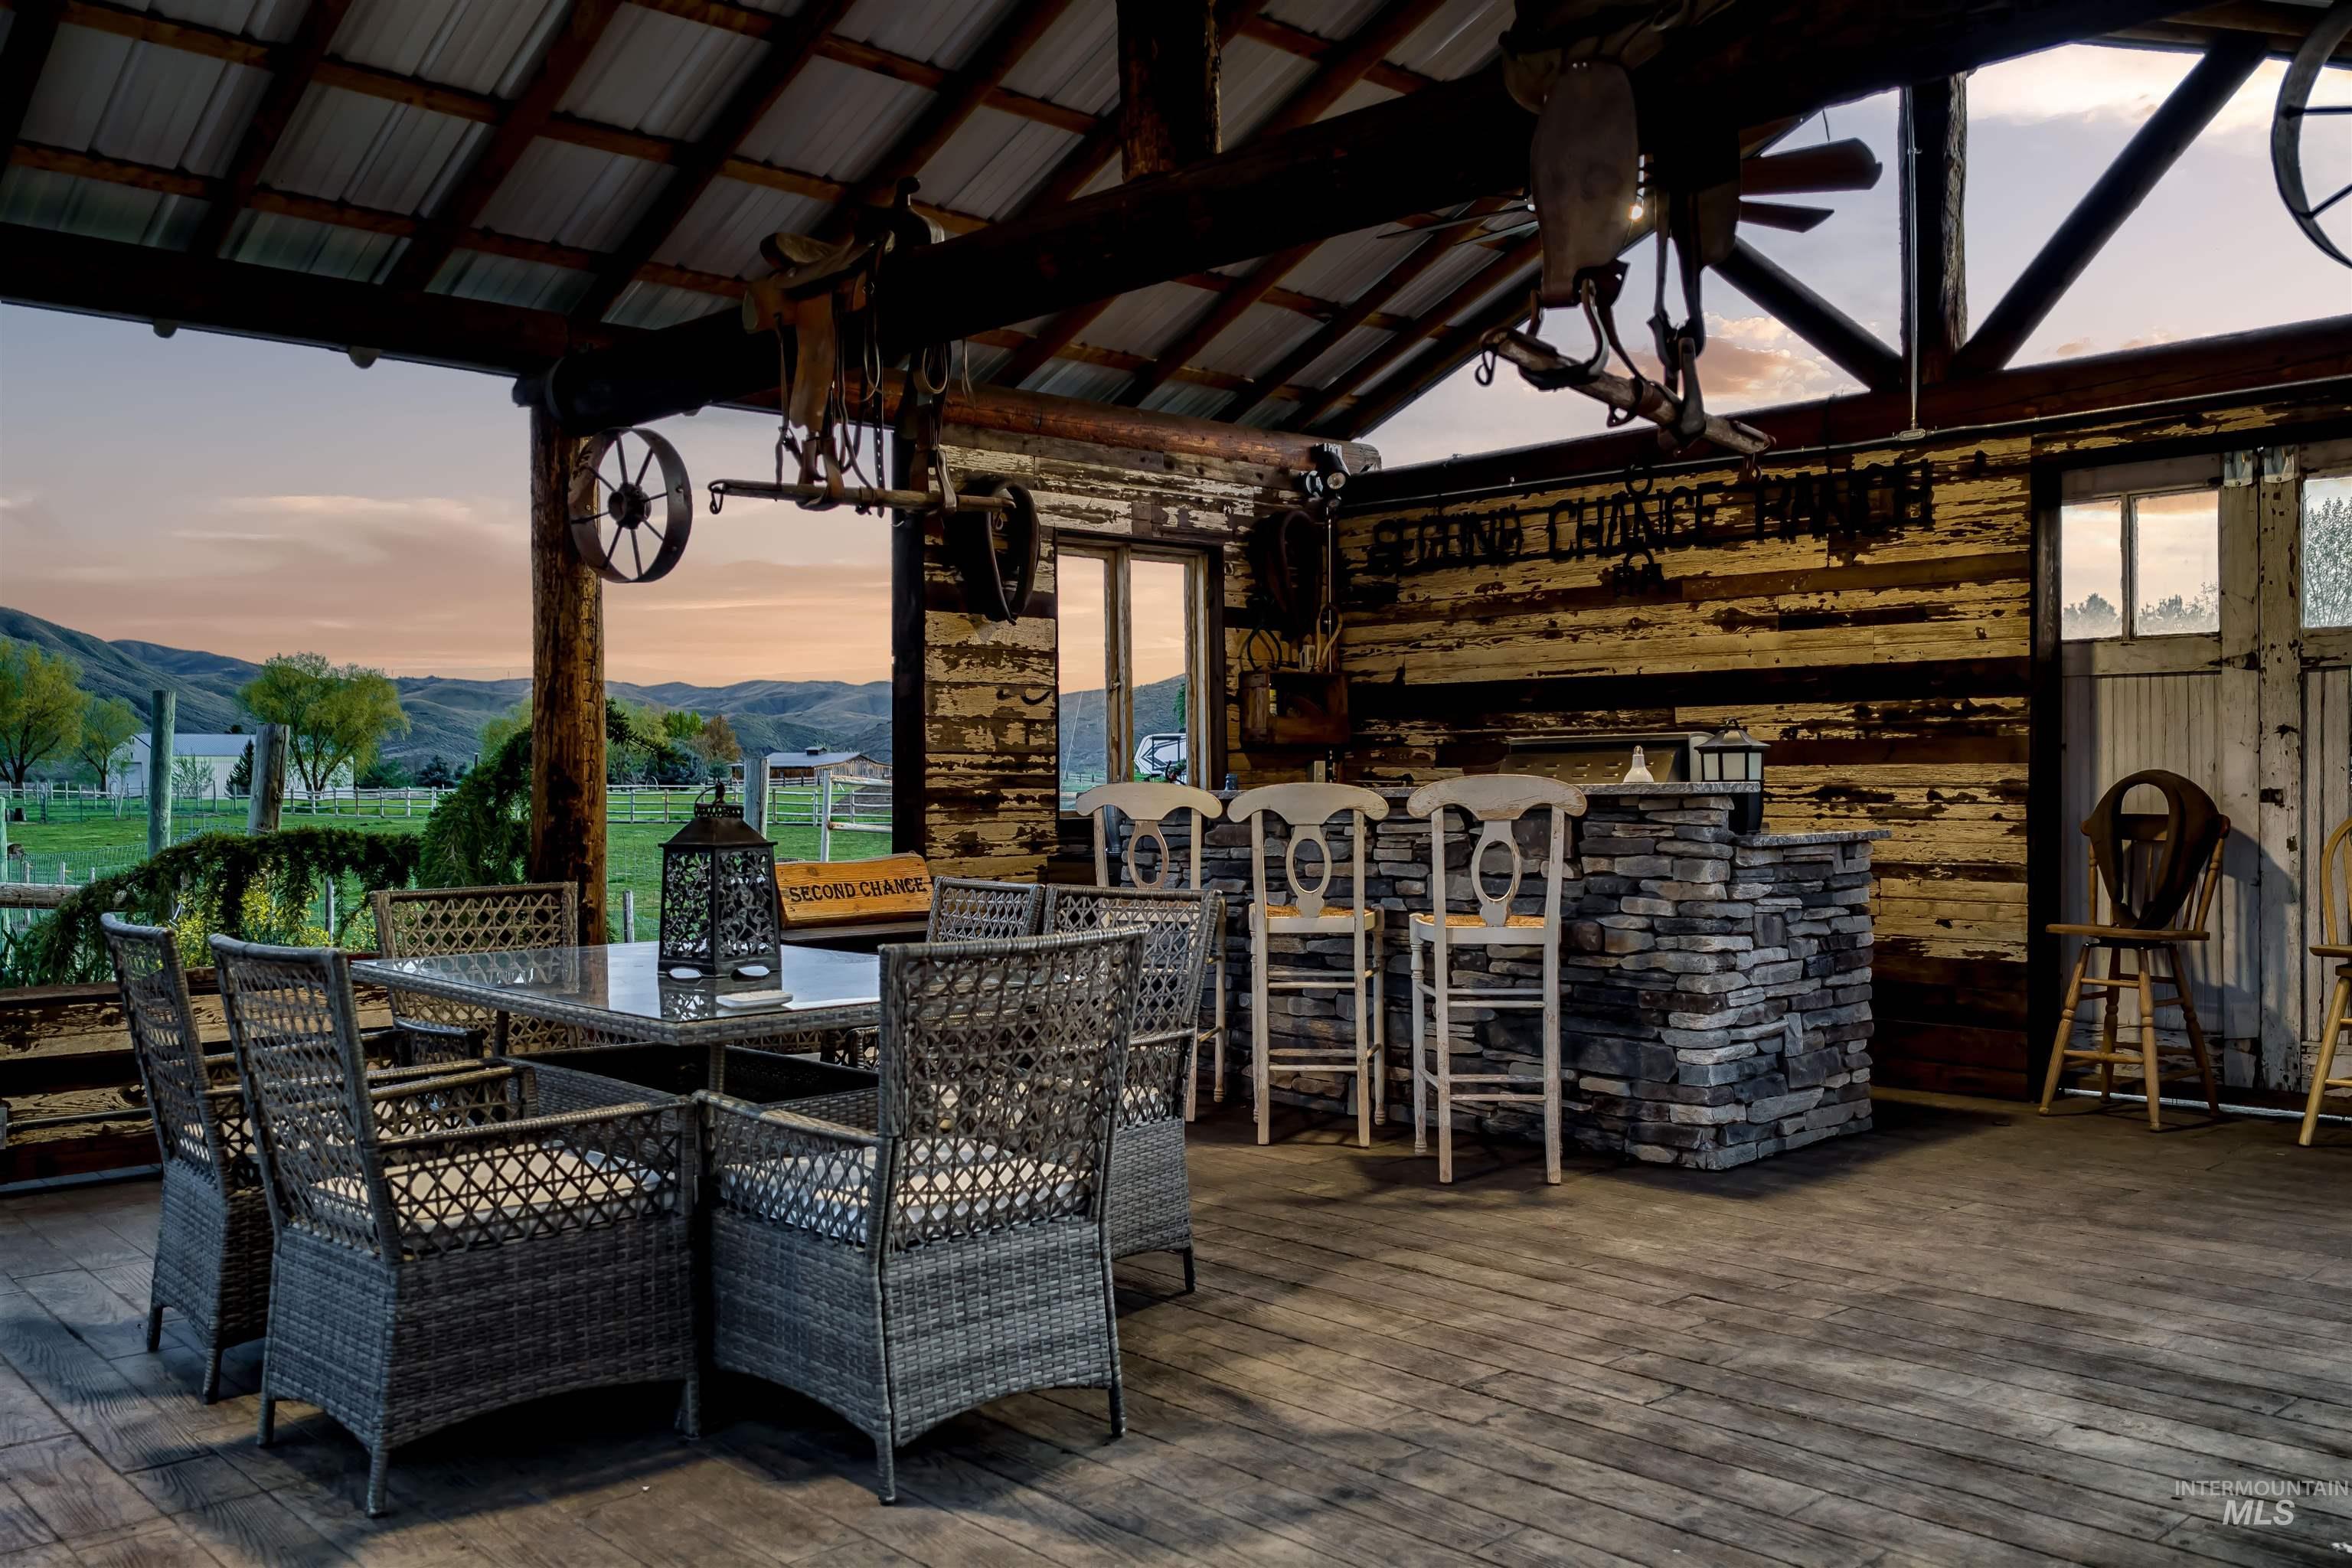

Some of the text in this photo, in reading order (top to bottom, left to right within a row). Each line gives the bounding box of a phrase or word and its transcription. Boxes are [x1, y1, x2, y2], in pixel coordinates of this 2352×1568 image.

[1547, 479, 1719, 562] CHANCE
[789, 877, 928, 903] SECOND CHANCE
